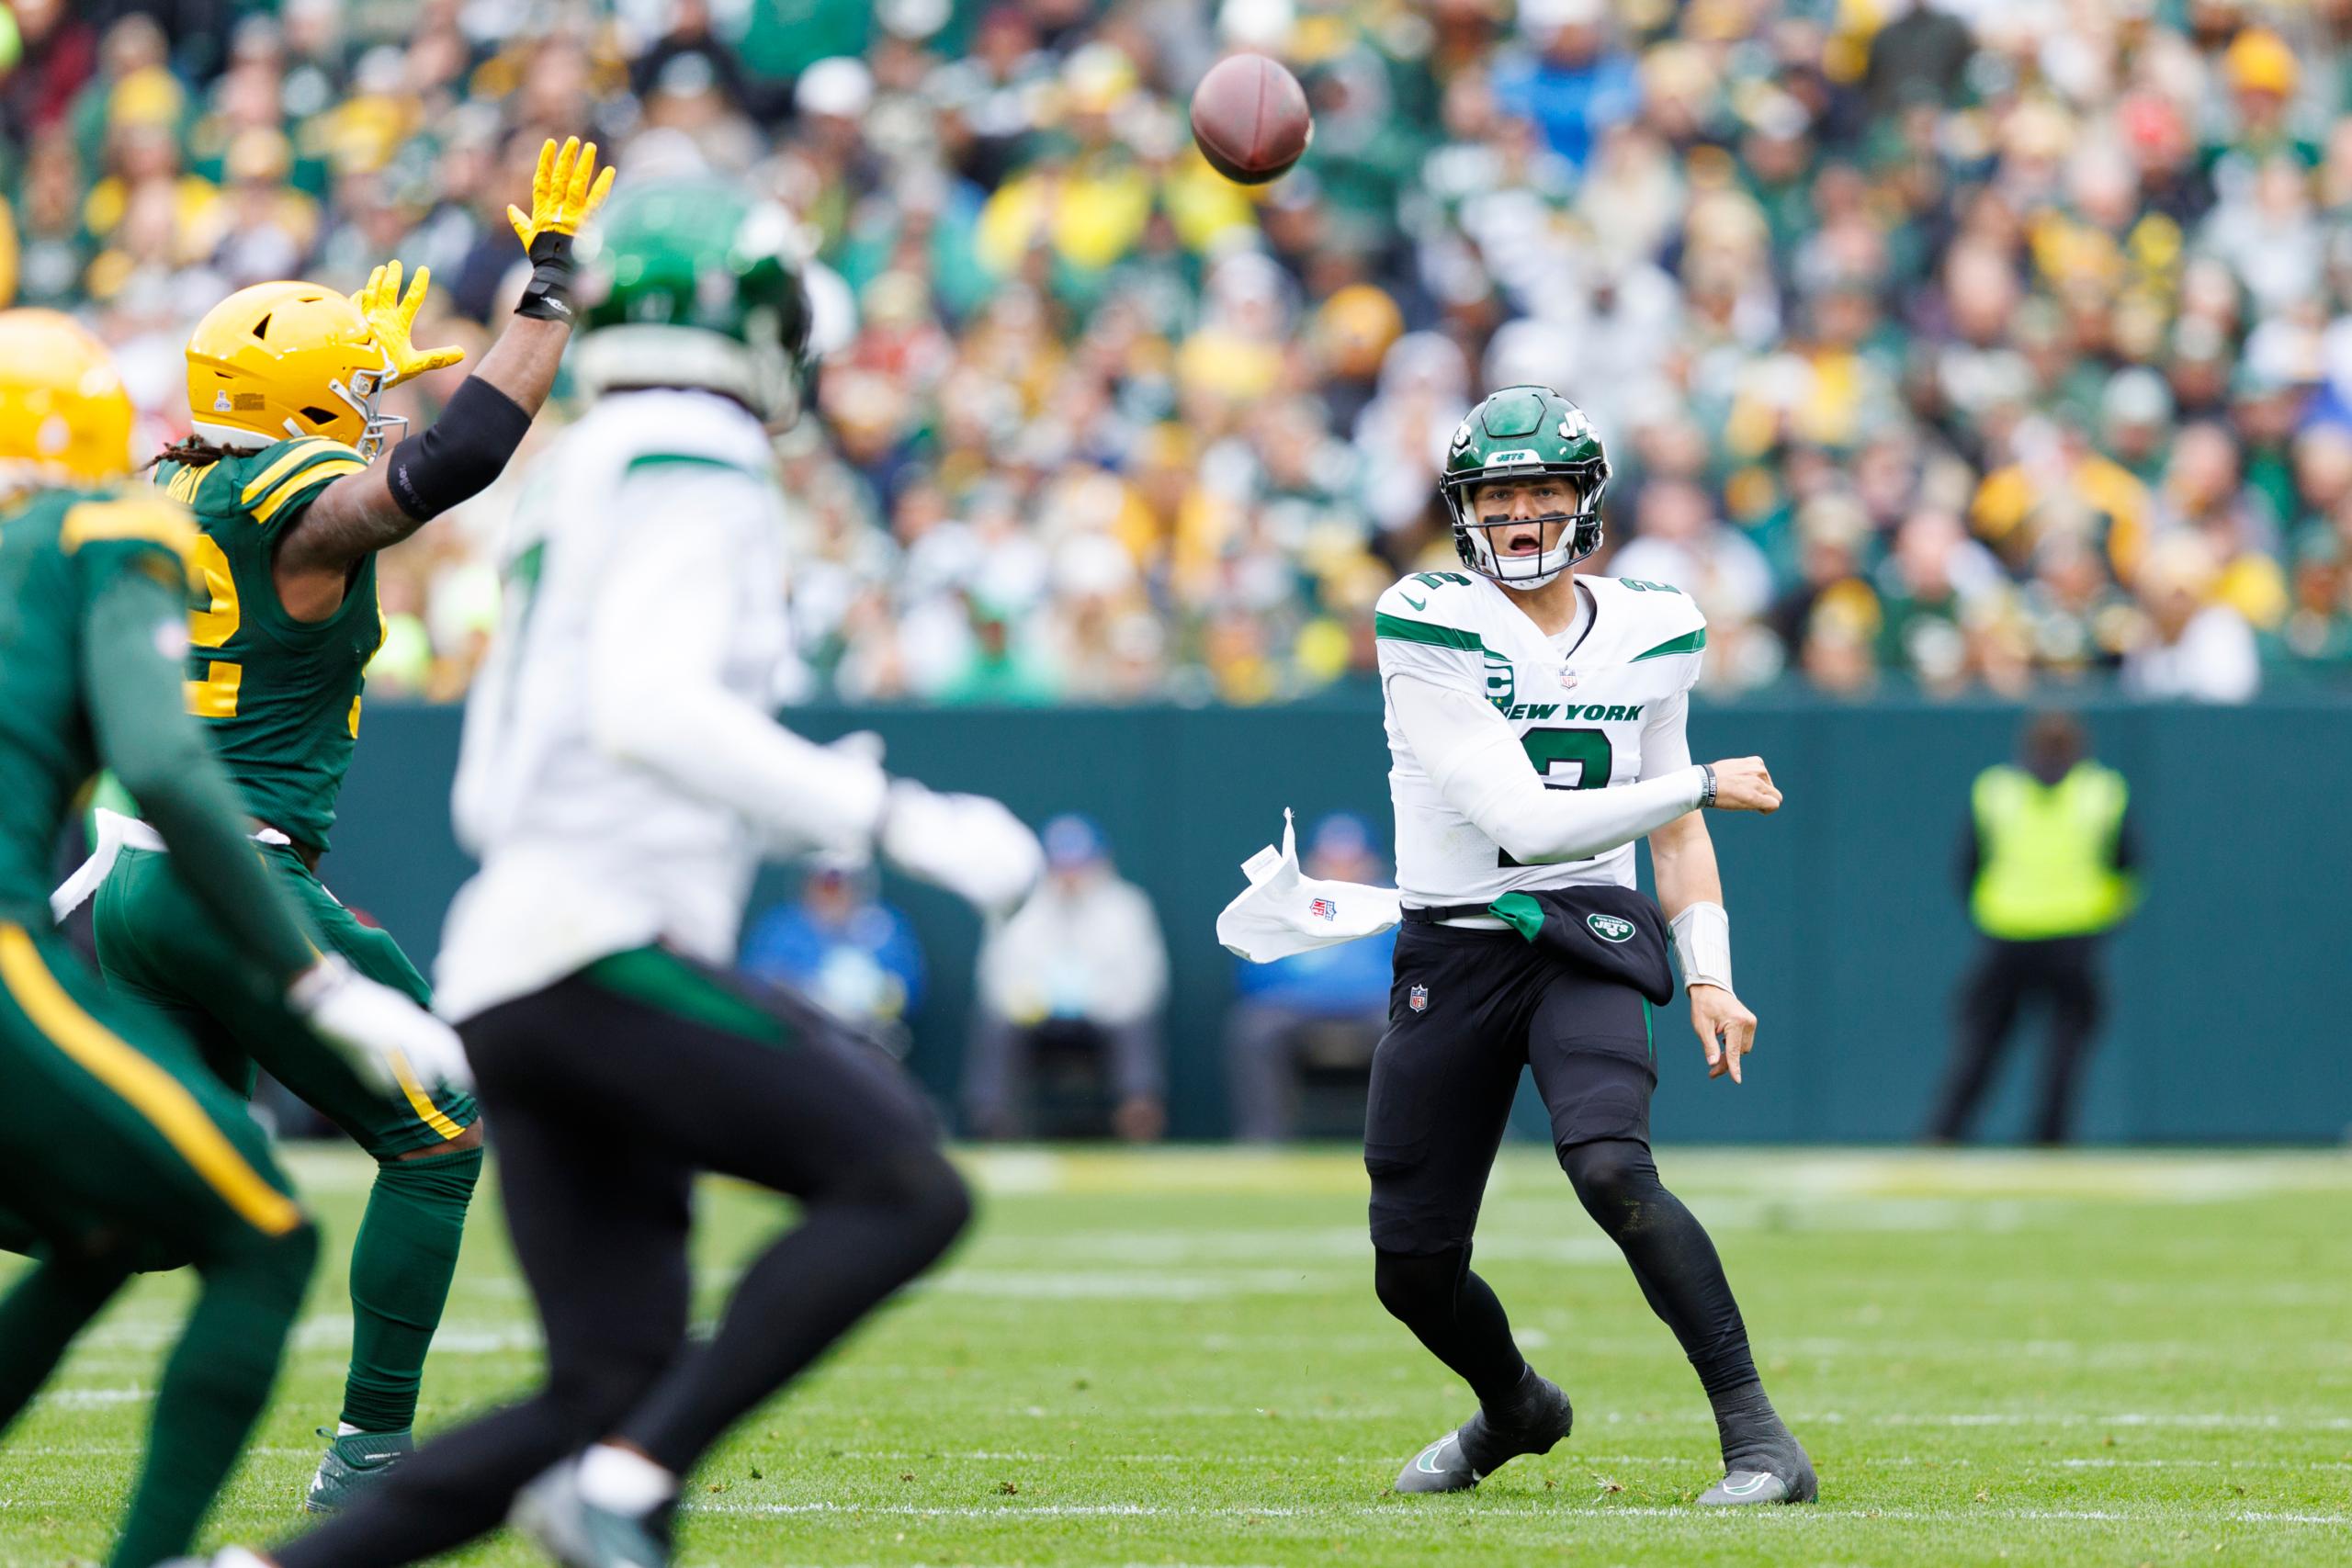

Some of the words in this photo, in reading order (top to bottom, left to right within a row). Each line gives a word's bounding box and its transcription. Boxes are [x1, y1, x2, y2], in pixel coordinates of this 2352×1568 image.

[1497, 453, 1525, 462] JETS
[1487, 667, 1513, 697] C
[1565, 705, 1645, 721] YORK
[1594, 920, 1629, 933] JETS
